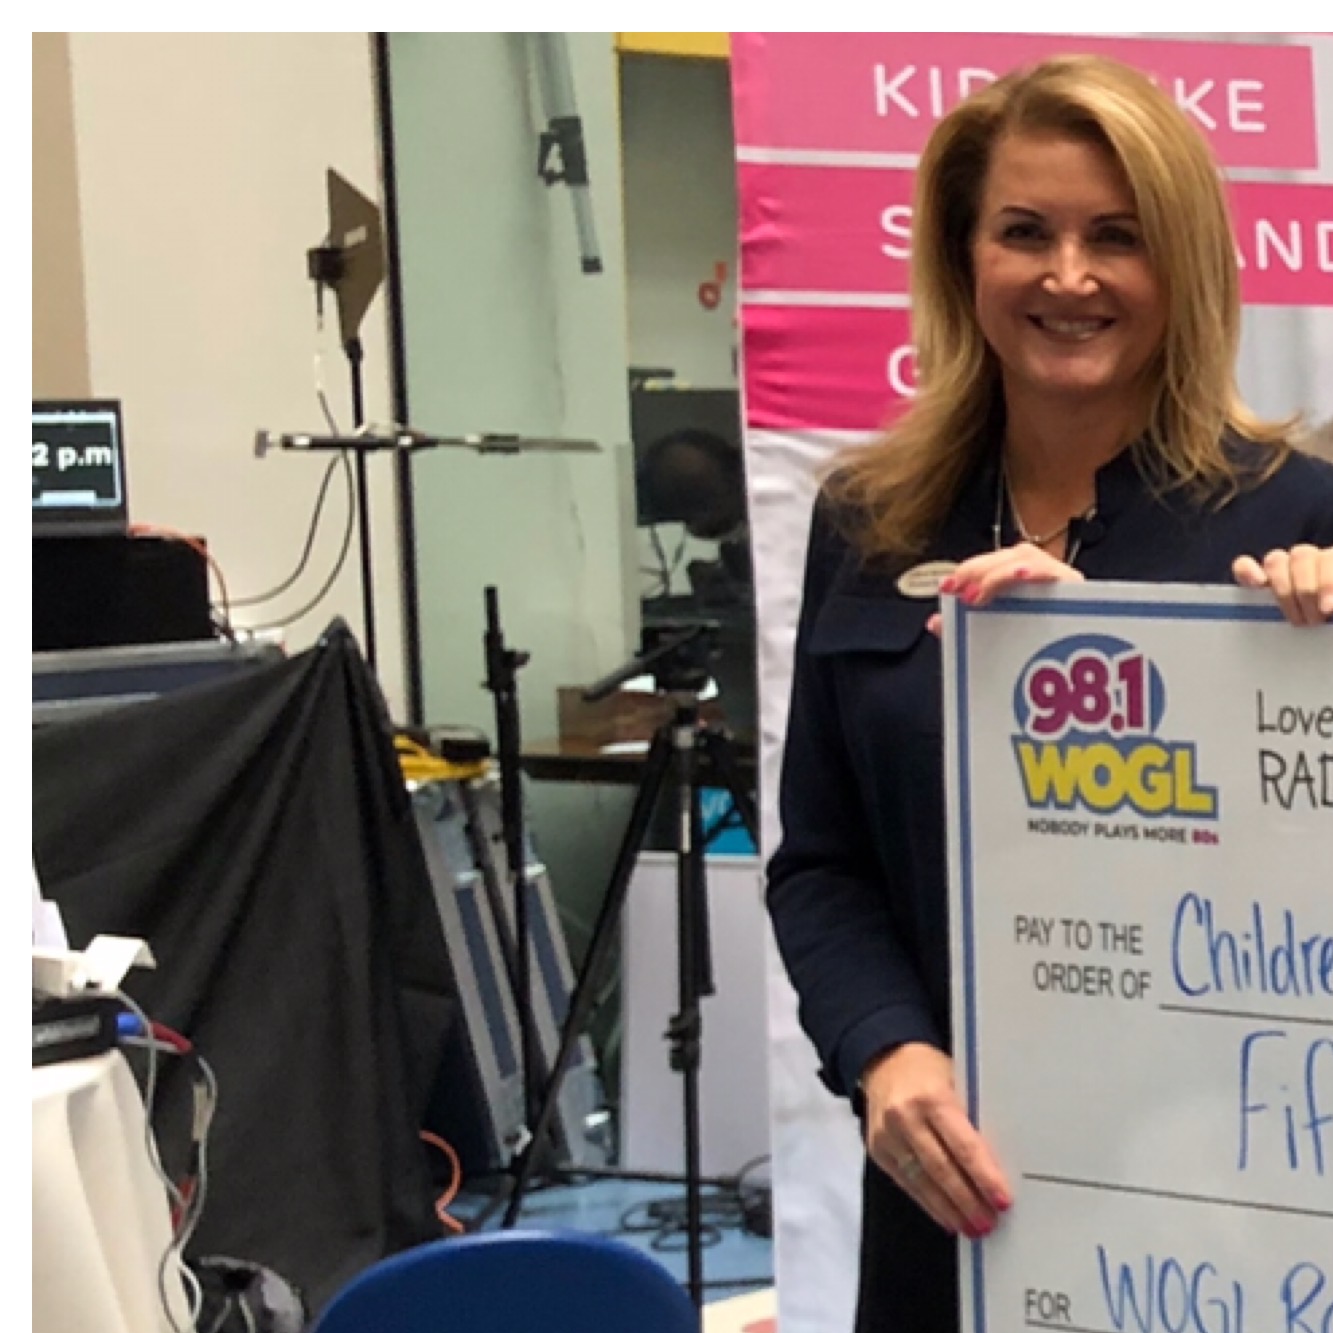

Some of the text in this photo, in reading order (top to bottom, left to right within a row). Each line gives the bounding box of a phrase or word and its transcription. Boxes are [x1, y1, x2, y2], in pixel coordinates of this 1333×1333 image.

[1177, 78, 1267, 131] KE
[1026, 651, 1146, 737] 98.1
[1013, 738, 1217, 818] WOGL
[1027, 819, 1090, 838] NOBODY
[1094, 823, 1140, 842] PLAYS
[1142, 826, 1187, 844] MORE
[1014, 915, 1143, 954] PAY TO THE
[1033, 961, 1152, 999] ORDER OF
[1024, 1288, 1072, 1321] FOR
